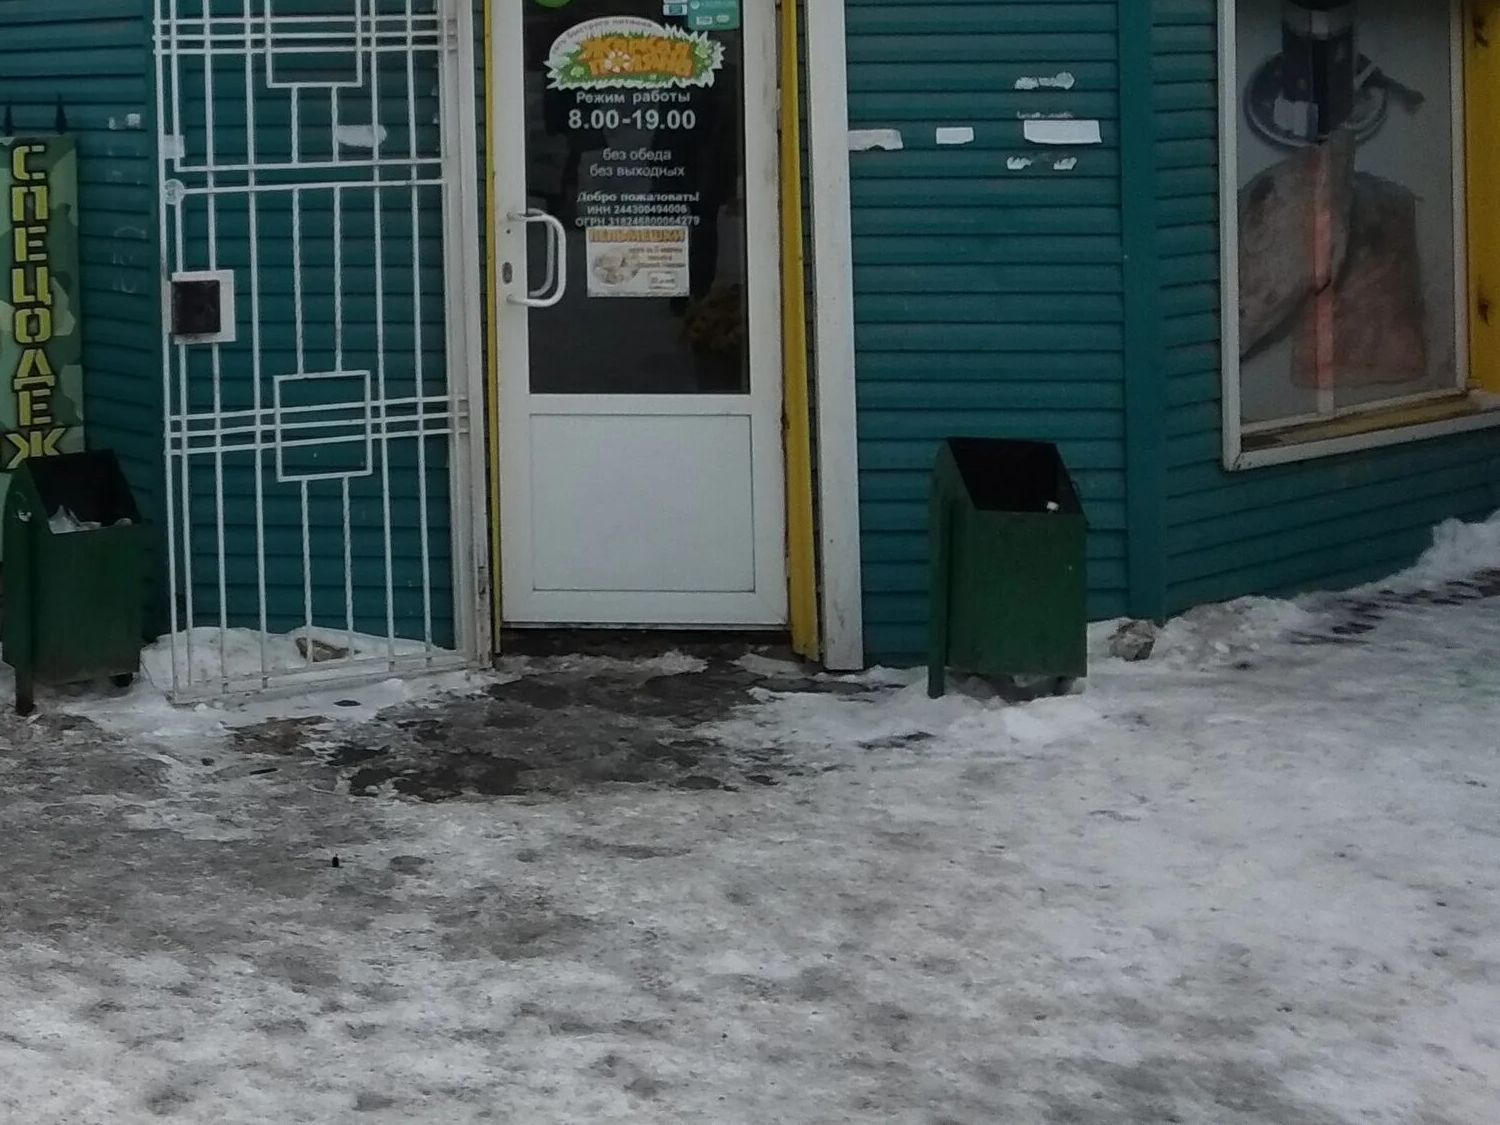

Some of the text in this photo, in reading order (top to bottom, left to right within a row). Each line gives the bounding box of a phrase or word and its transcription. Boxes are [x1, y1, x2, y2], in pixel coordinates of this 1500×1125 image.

[576, 89, 690, 104] Режим работы
[568, 108, 696, 129] 8.00-19.00
[602, 147, 672, 162] без обеда
[589, 163, 685, 178] без выходных
[577, 191, 617, 203] Добро
